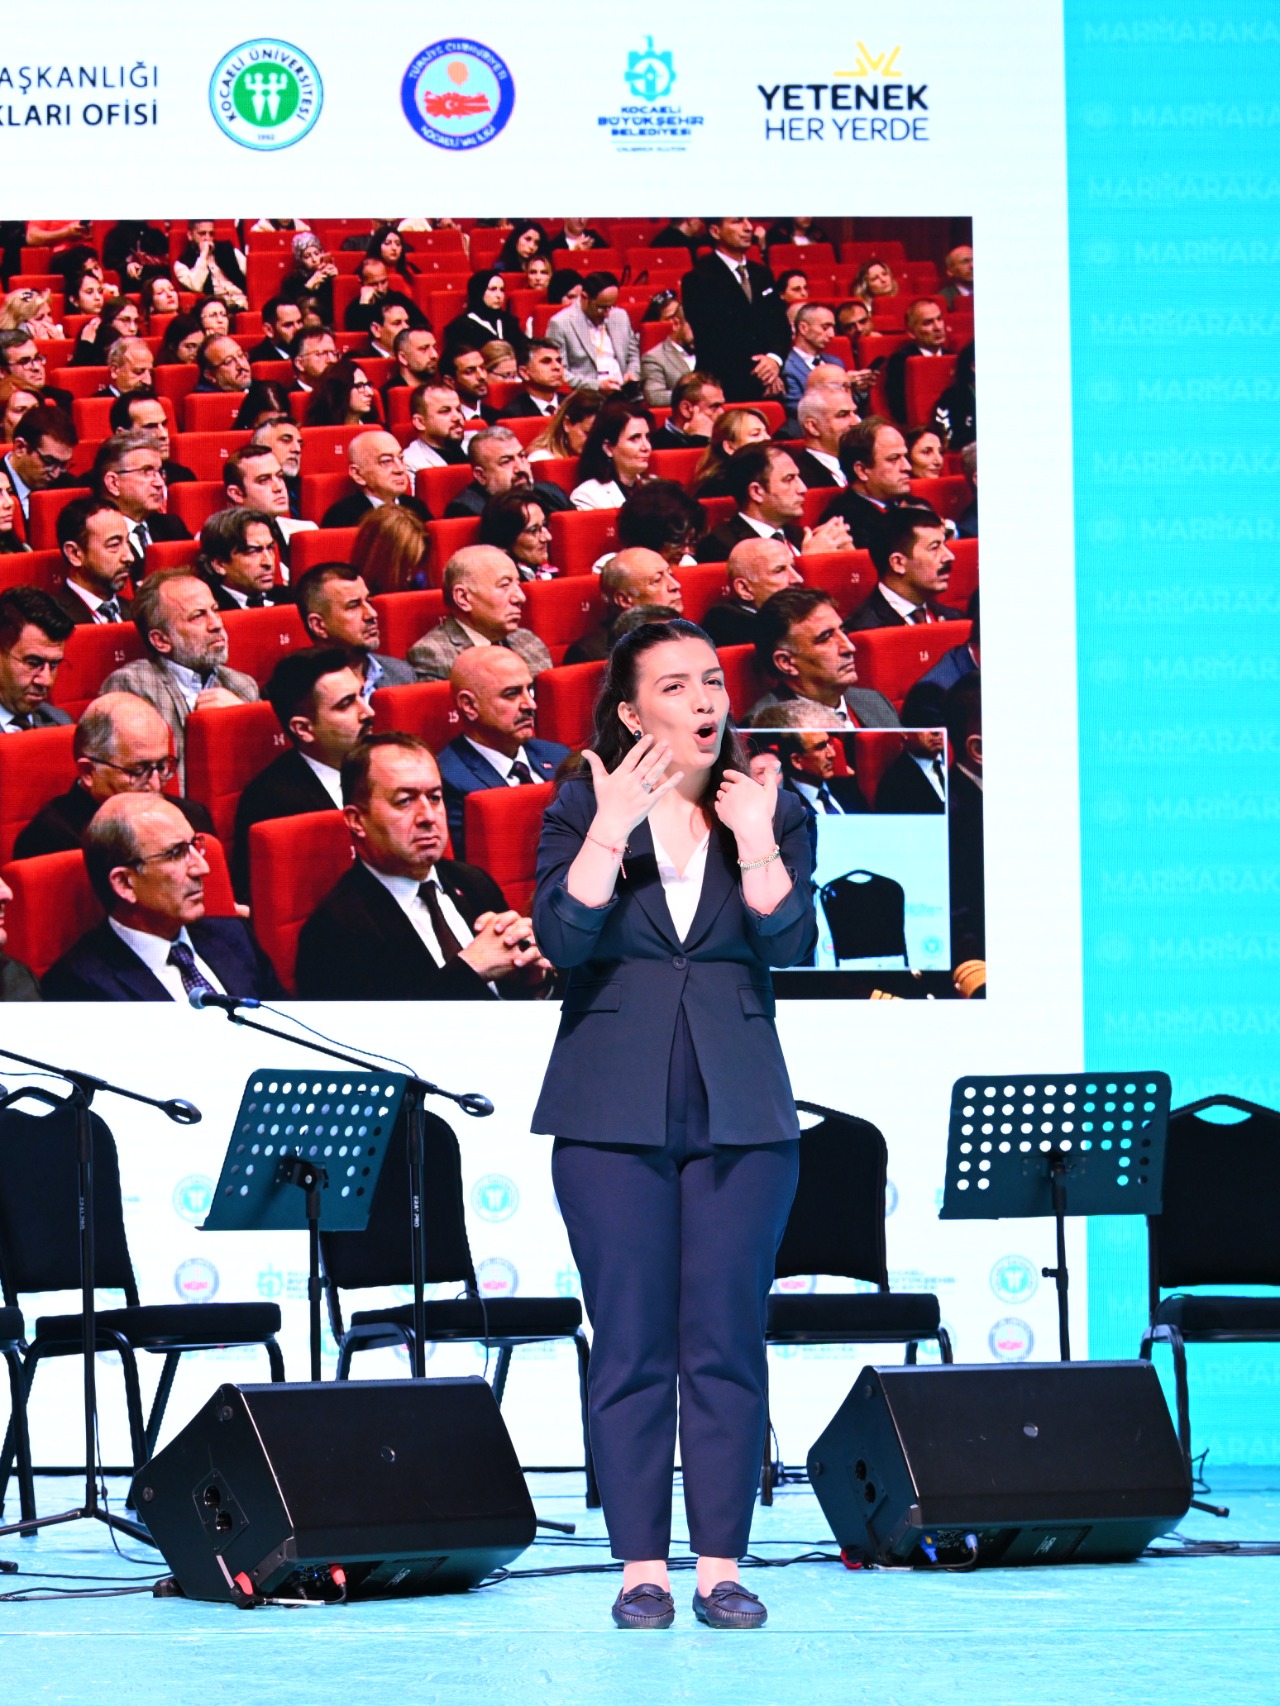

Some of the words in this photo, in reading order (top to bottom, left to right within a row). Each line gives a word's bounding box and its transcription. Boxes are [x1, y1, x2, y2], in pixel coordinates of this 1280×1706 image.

[249, 47, 314, 123] ÜNİVERSİTESİ
[757, 84, 929, 111] YETENEK
[82, 99, 158, 127] OFİSİ
[765, 117, 824, 141] HER
[831, 117, 930, 141] YERDE
[279, 633, 290, 645] 16
[114, 650, 126, 661] 15
[273, 733, 285, 745] 14
